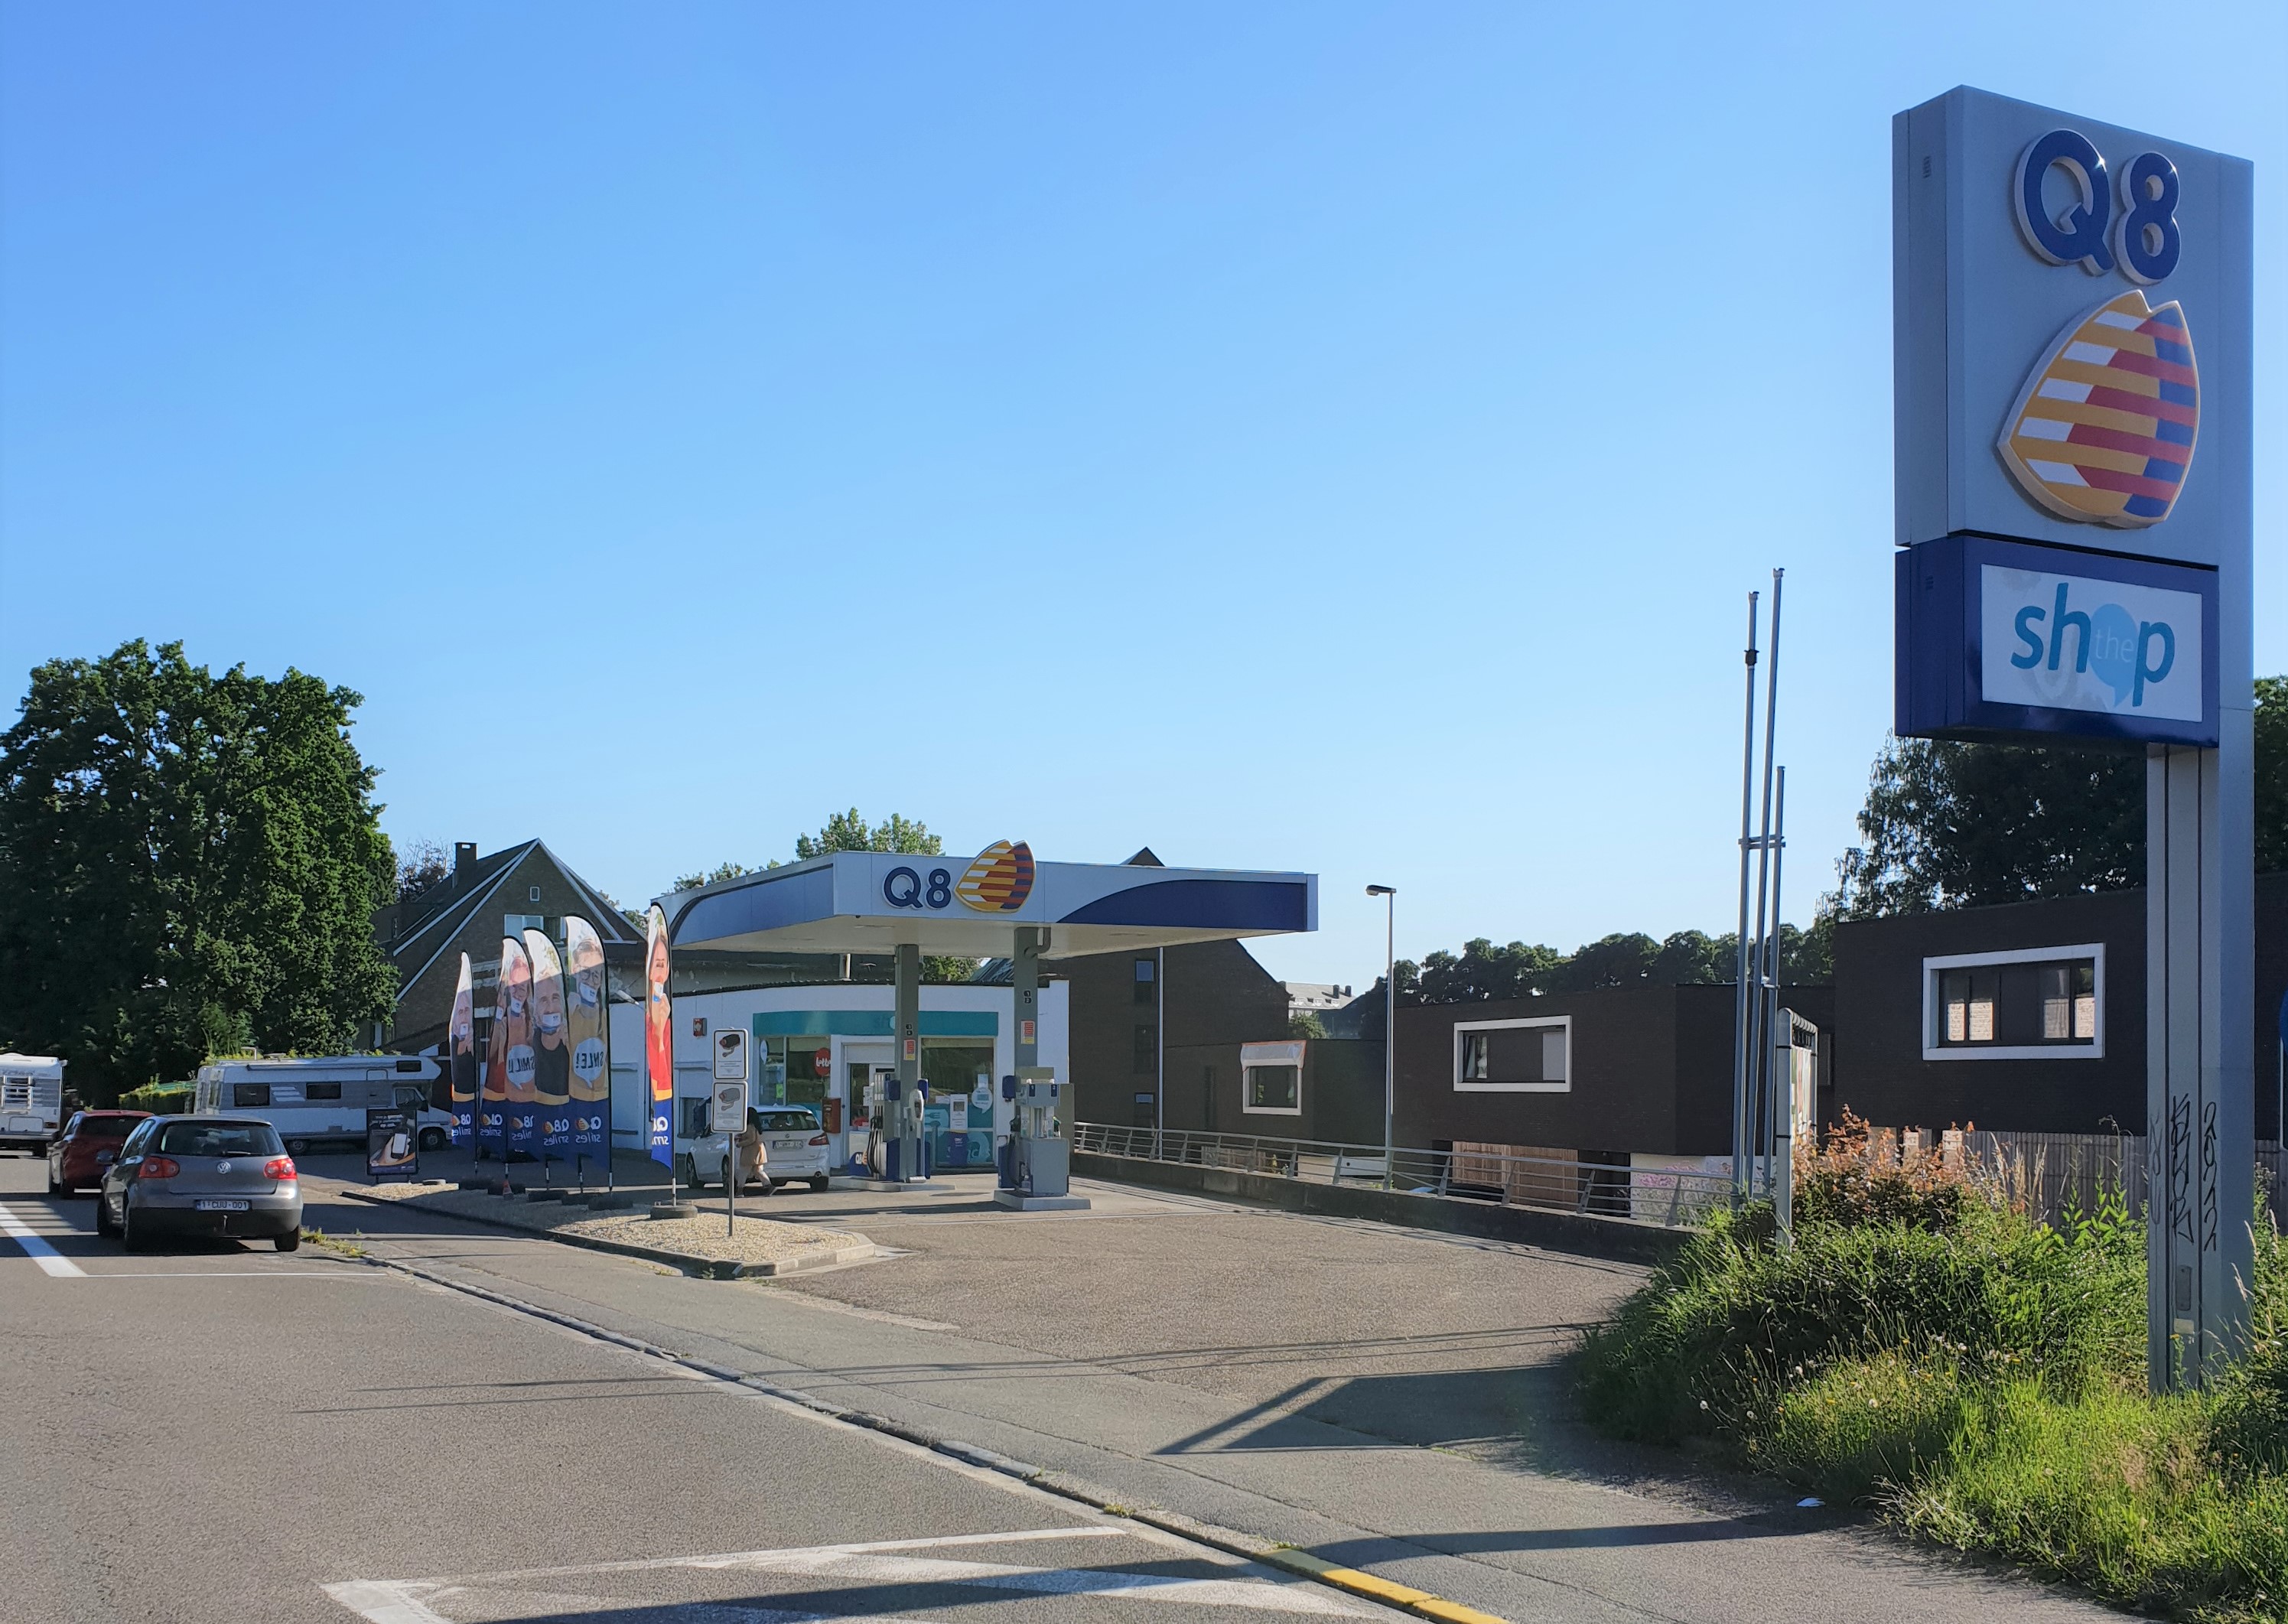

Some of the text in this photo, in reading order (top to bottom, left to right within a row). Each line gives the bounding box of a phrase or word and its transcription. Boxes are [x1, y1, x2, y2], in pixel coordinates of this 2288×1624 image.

[2015, 128, 2181, 285] Q8
[2095, 626, 2133, 662] the
[883, 867, 952, 910] Q8
[815, 1056, 831, 1067] lott
